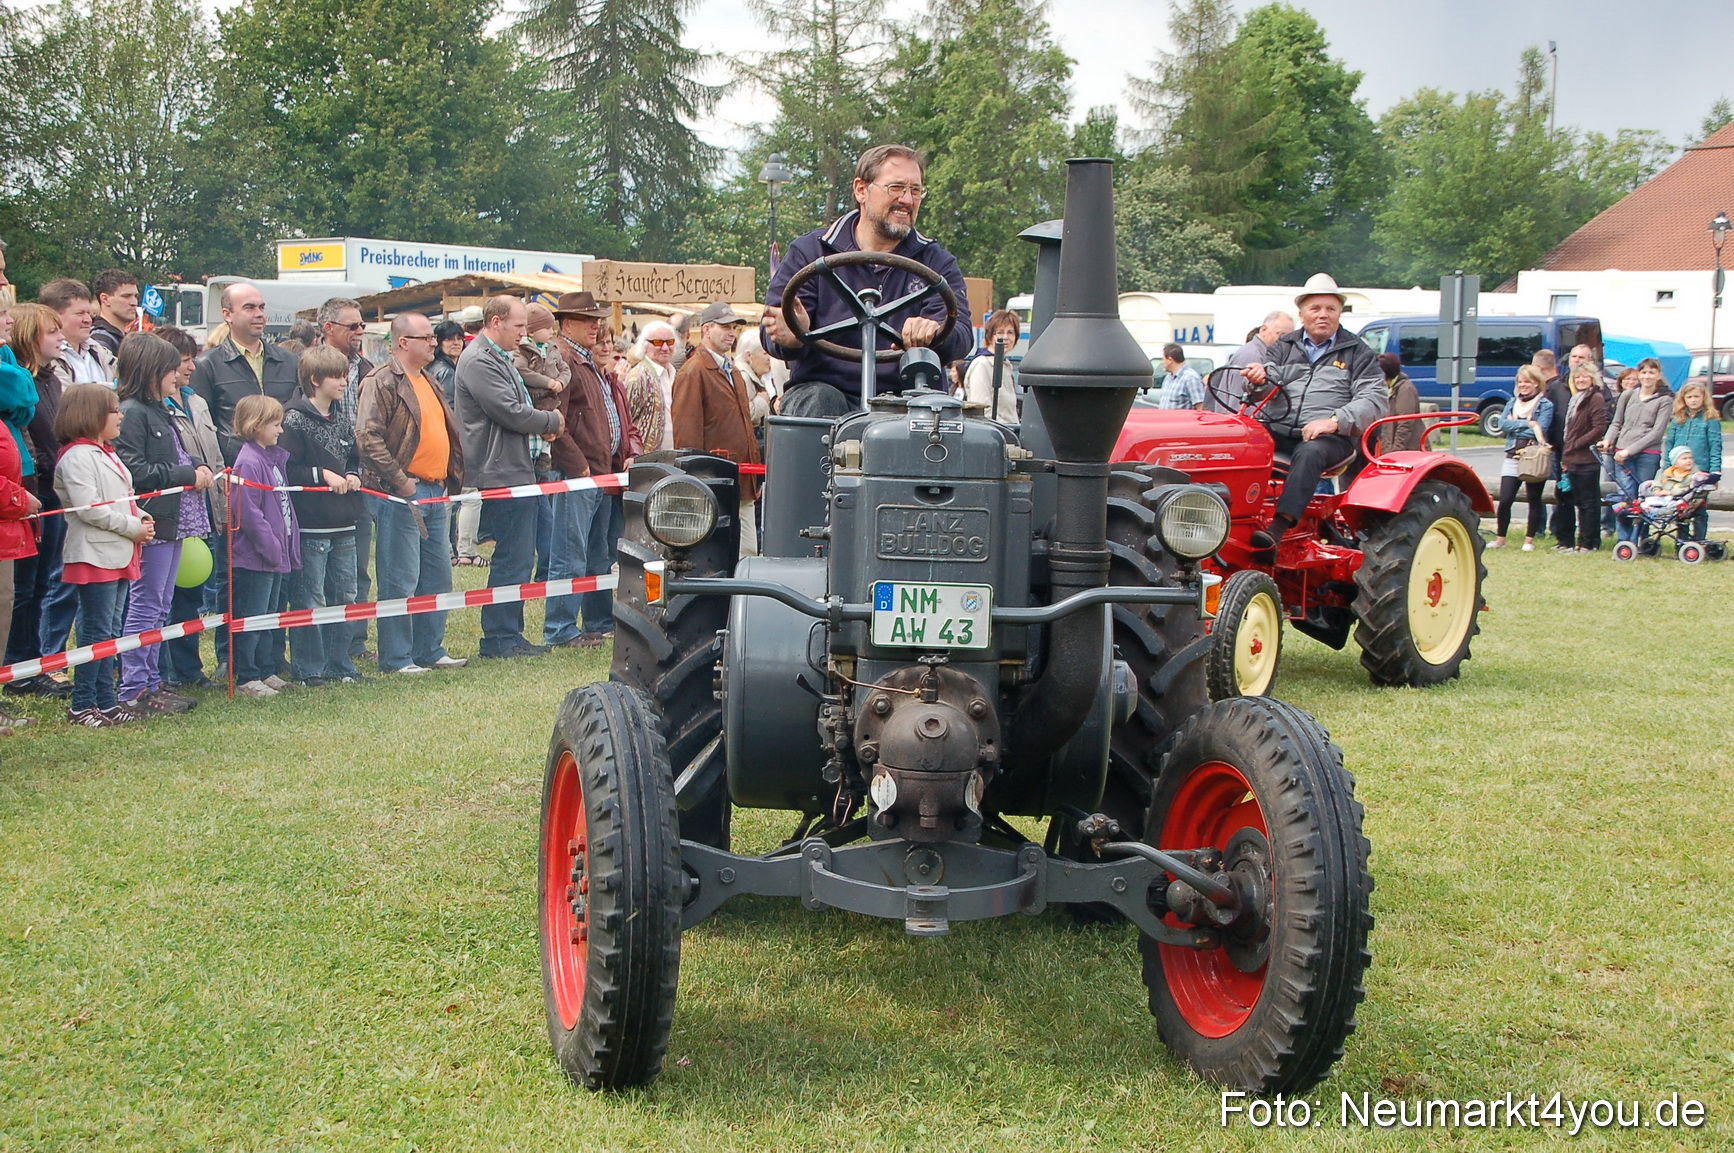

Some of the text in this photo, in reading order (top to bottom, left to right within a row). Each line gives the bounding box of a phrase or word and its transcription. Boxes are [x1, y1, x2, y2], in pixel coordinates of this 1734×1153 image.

[360, 247, 515, 274] Preisbrecher im Internet!
[615, 267, 737, 301] Staufer Bergesel
[902, 511, 965, 534] LANZ
[880, 532, 985, 556] BULLDOG
[880, 600, 888, 610] D
[900, 587, 938, 614] NM
[890, 617, 974, 645] AW 43
